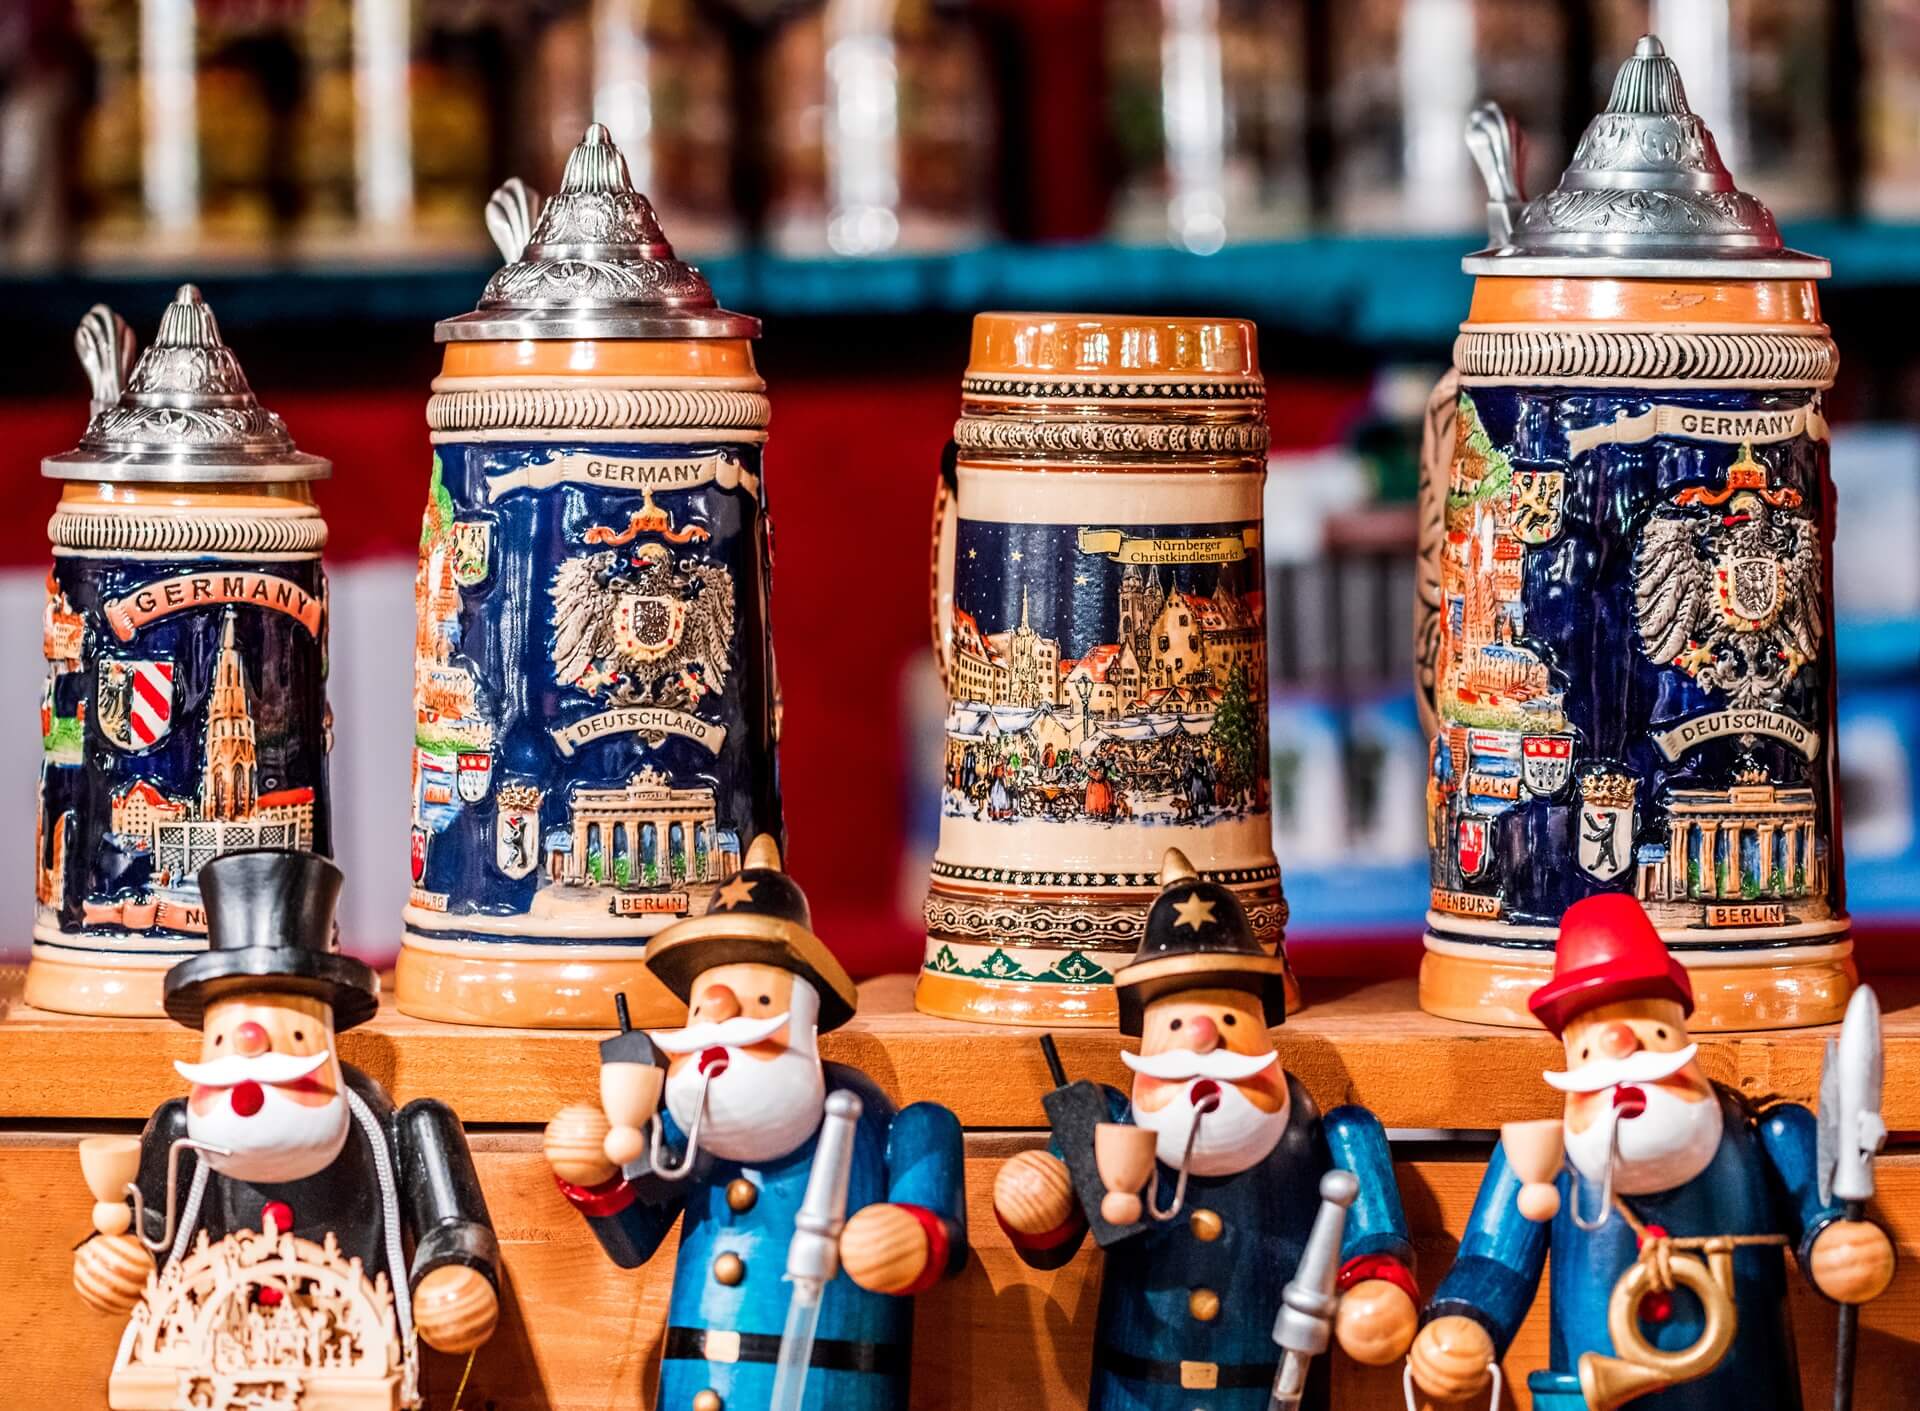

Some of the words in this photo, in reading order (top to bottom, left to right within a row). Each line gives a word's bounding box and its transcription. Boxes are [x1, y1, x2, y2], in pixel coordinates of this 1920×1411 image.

[1681, 414, 1795, 436] GERMANY
[587, 461, 702, 483] GERMANY
[1130, 550, 1239, 562] Christkindlesmarkt
[1153, 540, 1222, 552] Nürnberger
[135, 577, 308, 614] GERMANY
[577, 712, 707, 738] DEUTSCHLAND
[1681, 714, 1805, 743] DEUTSCHLAND
[622, 898, 682, 910] BERLIN
[1716, 906, 1780, 923] BERLIN
